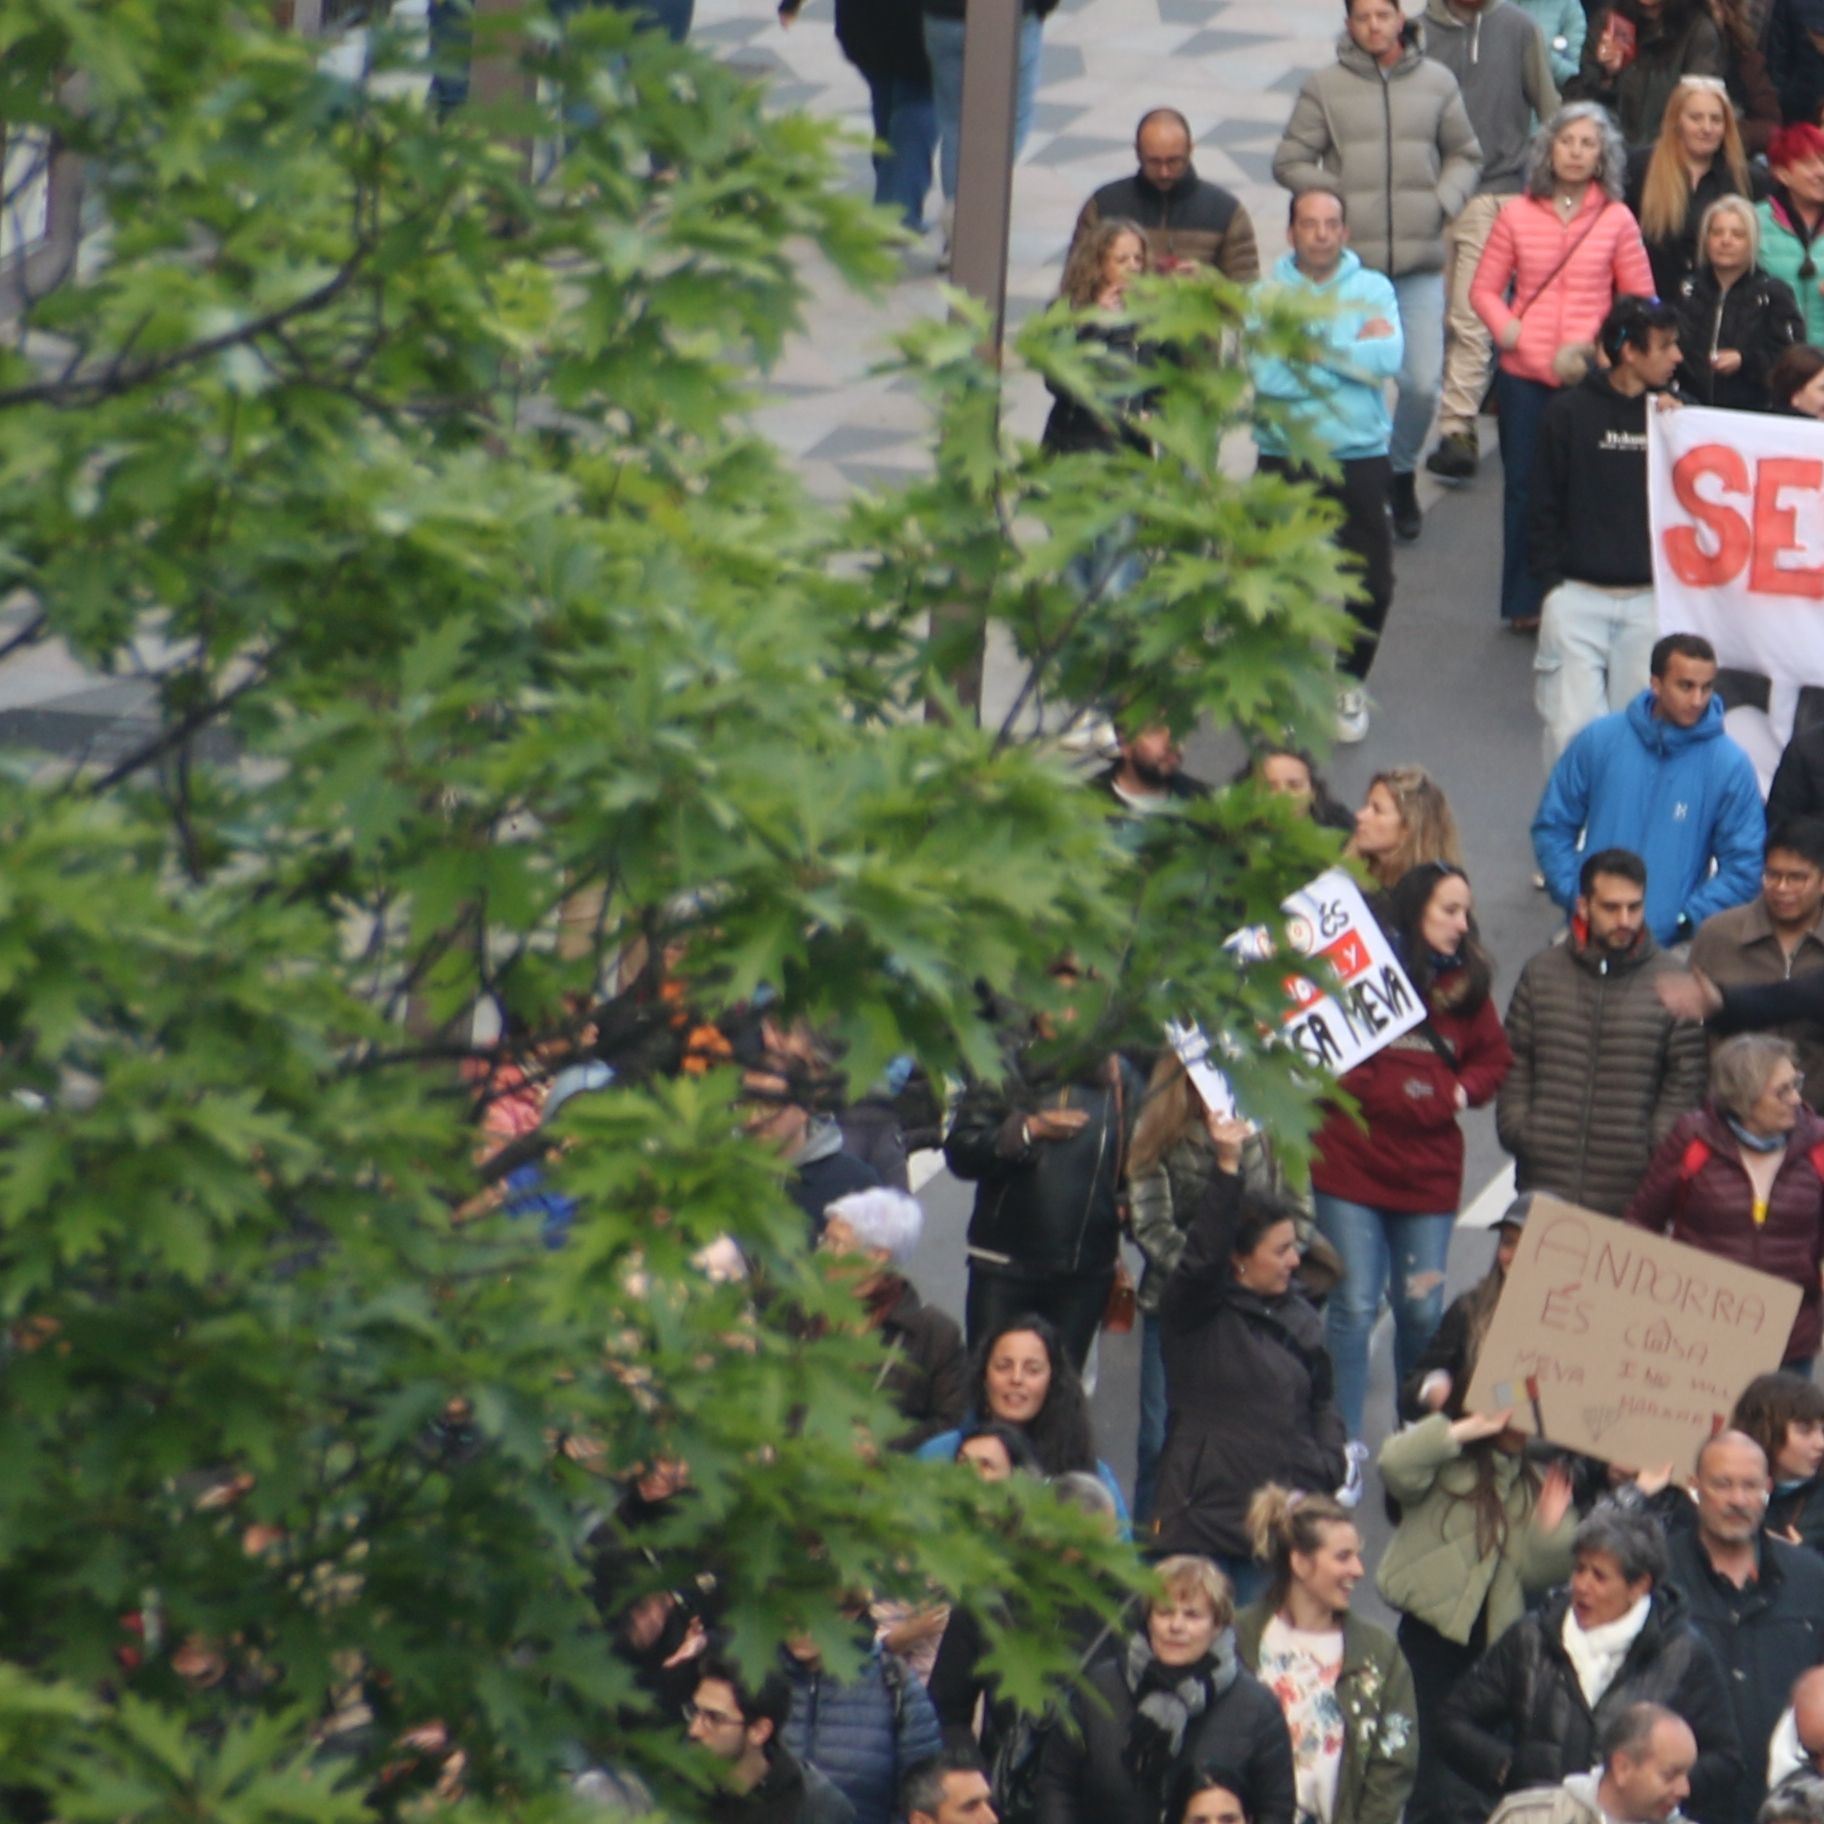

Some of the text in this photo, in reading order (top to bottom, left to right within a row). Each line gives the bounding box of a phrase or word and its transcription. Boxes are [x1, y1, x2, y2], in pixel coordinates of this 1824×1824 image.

[1344, 962, 1414, 1048] MEVA
[1534, 1215, 1767, 1334] ANDORRA
[1540, 1282, 1595, 1334] ÉS
